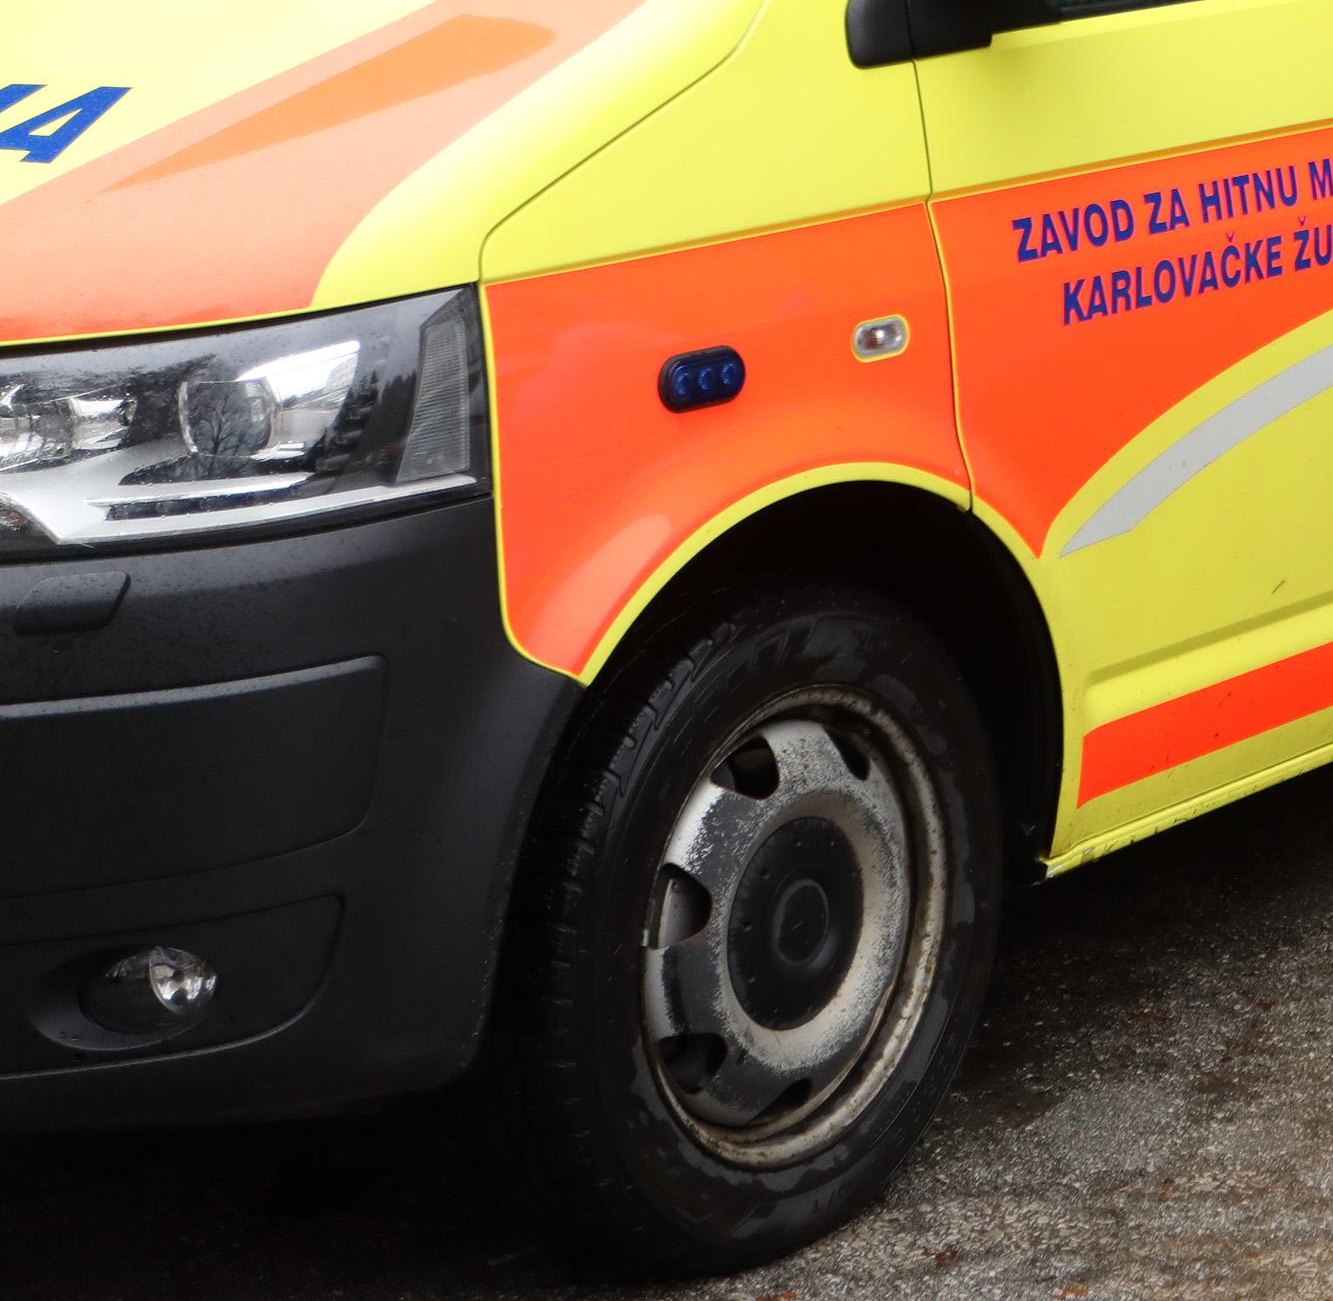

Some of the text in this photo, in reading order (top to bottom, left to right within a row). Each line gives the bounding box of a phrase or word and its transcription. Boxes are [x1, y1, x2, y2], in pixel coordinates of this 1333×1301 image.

[1012, 199, 1135, 263] ZAVOD
[1143, 188, 1190, 235] ZA
[1199, 165, 1298, 224] HITNU
[1063, 231, 1283, 326] KARLOVAČKE
